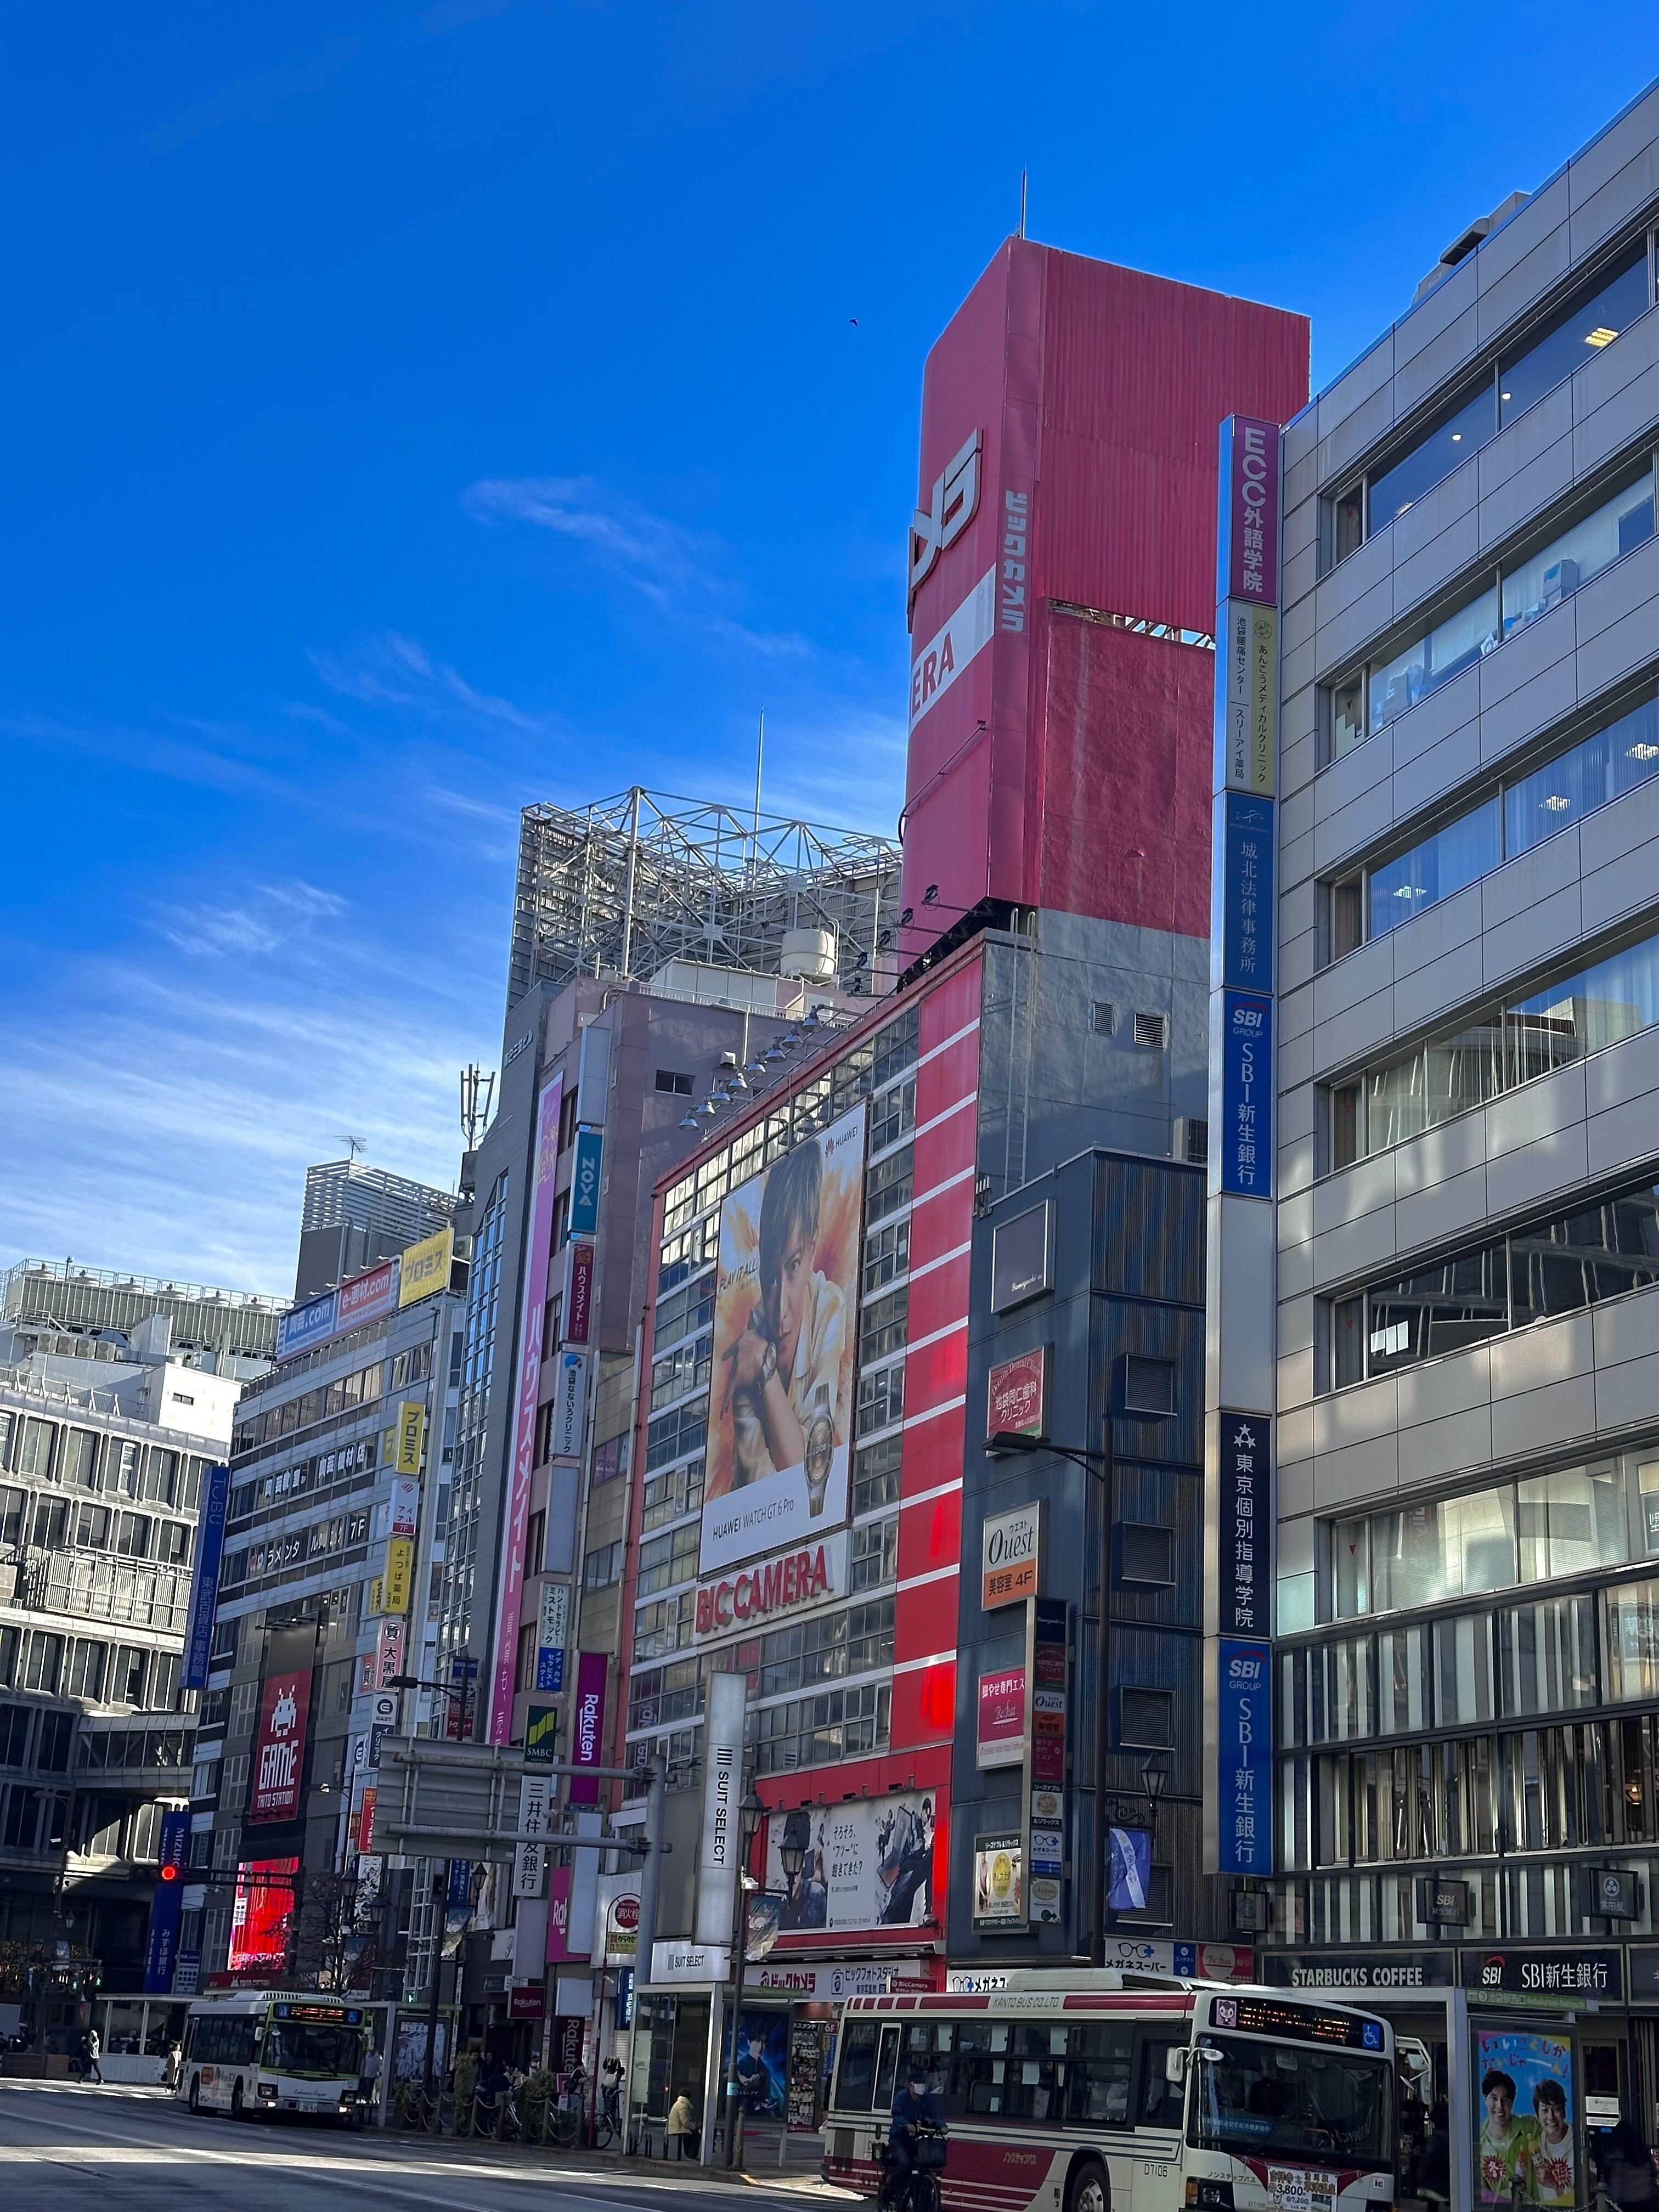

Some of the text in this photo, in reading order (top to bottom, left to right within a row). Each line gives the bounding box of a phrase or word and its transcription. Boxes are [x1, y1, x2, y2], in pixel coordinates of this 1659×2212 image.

[1242, 426, 1267, 592] ECC外語学院
[1001, 489, 1028, 633] ビックカメラ
[1236, 616, 1246, 695] 池袋腰痛センター
[1234, 709, 1245, 780] スリーアイ薬局
[1240, 841, 1257, 974] 城北法律事務所
[1233, 1009, 1262, 1028] SBI
[1233, 1027, 1263, 1038] GROUP
[1238, 1043, 1256, 1185] SBI新生銀行
[835, 1126, 858, 1149] HUAWEI
[578, 1157, 595, 1206] NOVA
[405, 1249, 444, 1286] プロミス
[719, 1269, 736, 1293] PLAY
[577, 1266, 587, 1321] ハウスメイト
[563, 1368, 577, 1453] 池袋なないろクリニック
[1001, 1400, 1030, 1423] クリニック
[403, 1410, 421, 1465] プロミス
[509, 1302, 543, 1593] ハウスメイト
[208, 1477, 226, 1525] TOBU
[351, 1518, 365, 1540] 7F
[713, 1498, 794, 1541] HUAWEI WATCH GT 6 Pro
[988, 1528, 1035, 1565] Ouest
[1235, 1453, 1254, 1628] 東京個別指導学院
[696, 1545, 828, 1633] BIC CAMERA
[988, 1571, 1034, 1596] 美容室 4F
[381, 1646, 398, 1689] 大黒屋
[538, 1662, 546, 1688] スクール
[546, 1653, 555, 1686] セラピスト
[553, 1651, 562, 1684] メディカル
[1229, 1659, 1261, 1679] SBI
[1229, 1680, 1261, 1691] GROUP
[578, 1693, 600, 1761] Rakuten
[258, 1739, 299, 1791] GAME
[527, 1747, 552, 1758] SMBC
[1235, 1698, 1255, 1863] SBI新生銀行
[272, 1790, 295, 1807] STATION
[713, 1770, 729, 1865] SUIT SELECT
[617, 1907, 640, 1921] 消火栓
[1436, 1894, 1455, 1906] SBI
[157, 1928, 171, 1976] みずほ銀行
[674, 1955, 705, 1968] SUIT SELECT
[1104, 1959, 1167, 1972] メガネスーパー
[1291, 1966, 1423, 1987] STARBUCKS COFFEE
[1482, 1962, 1607, 1988] SBI SBI新生銀行
[514, 1998, 541, 2008] Rakuten
[993, 1997, 1017, 2007] KANTO
[1017, 1997, 1034, 2007] BUS
[562, 2018, 581, 2073] Rakute
[825, 2023, 835, 2033] 6F
[1207, 2171, 1256, 2183] ノンステップバス
